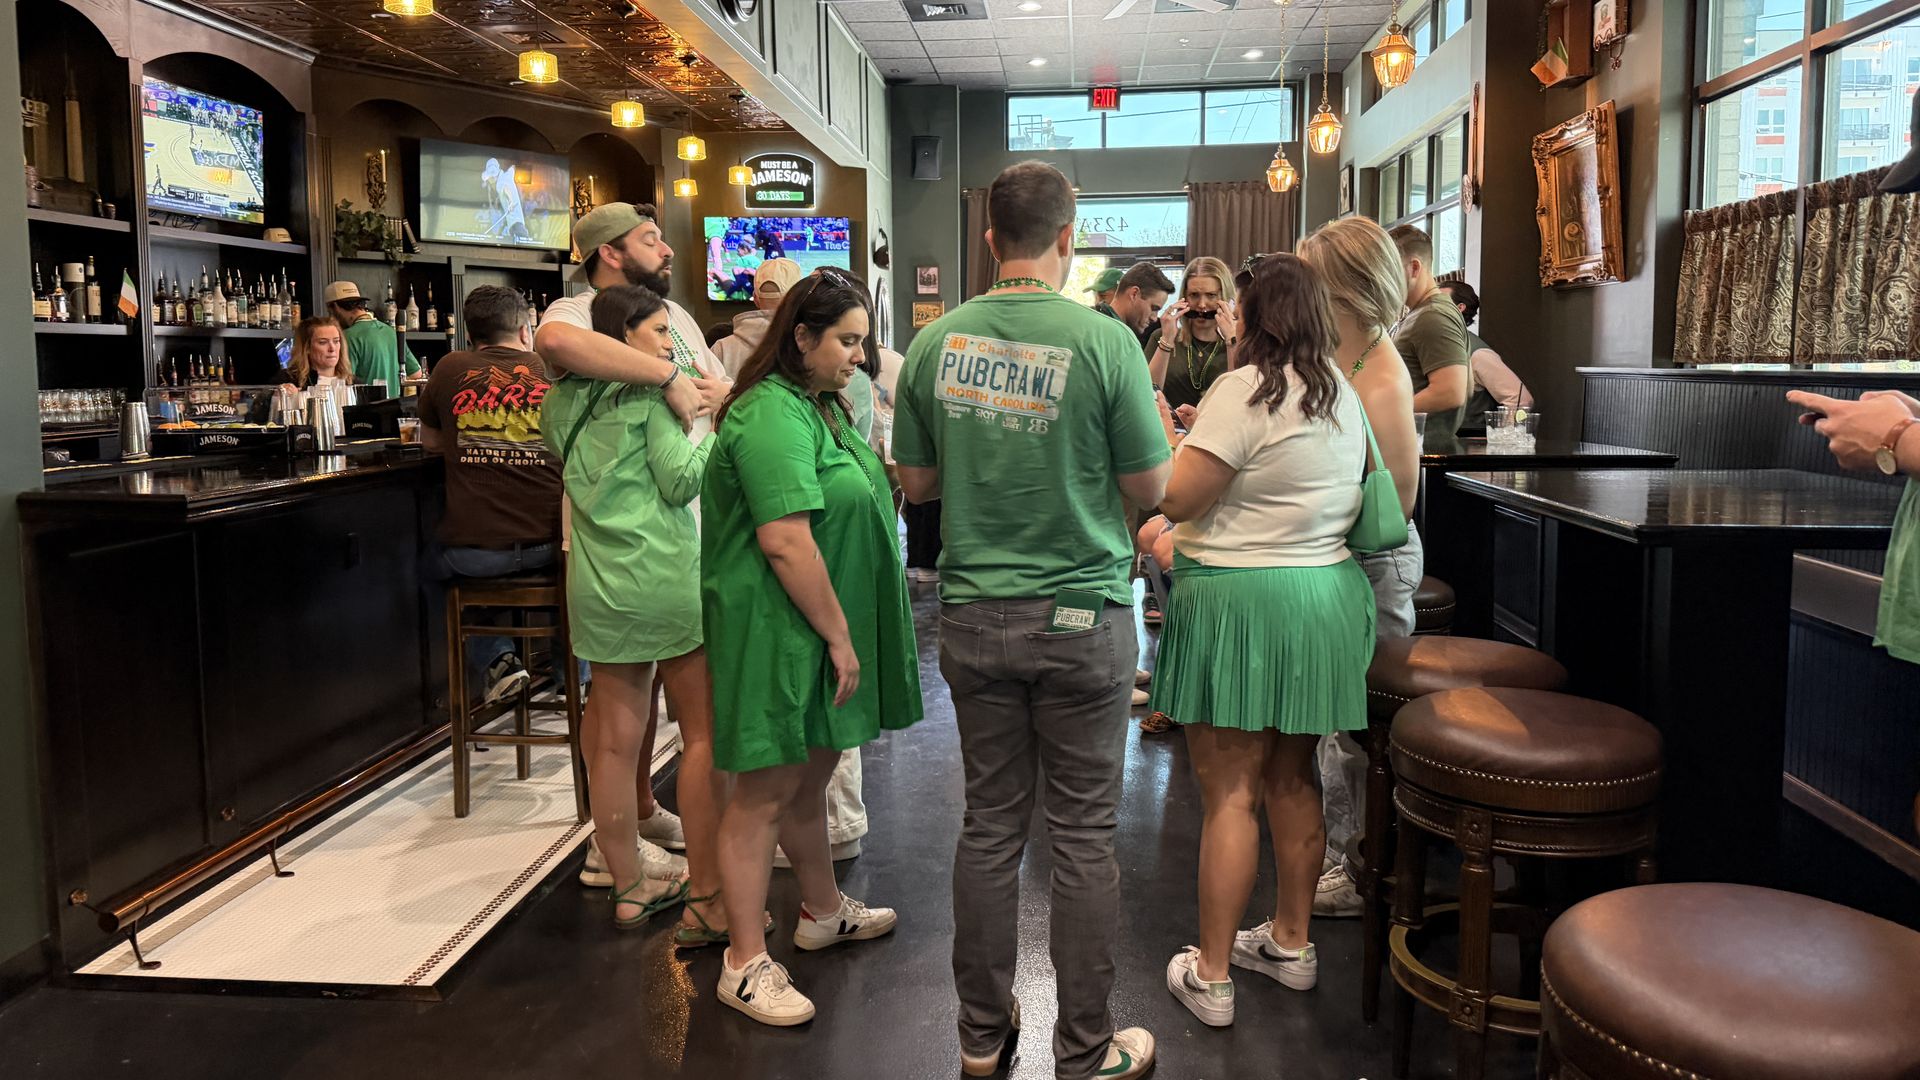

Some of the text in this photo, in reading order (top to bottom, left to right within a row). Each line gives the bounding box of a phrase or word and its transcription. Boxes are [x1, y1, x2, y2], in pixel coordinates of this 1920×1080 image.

[1093, 89, 1117, 108] EXIT
[760, 161, 799, 169] MUST BE A
[750, 170, 808, 187] JAMESON
[769, 190, 791, 200] DAYS
[824, 241, 842, 250] The
[977, 342, 1037, 361] Charlotte
[940, 351, 1058, 401] PUBCRAWL
[946, 386, 1047, 413] NORTH CAROLINA
[195, 404, 236, 415] JAMESON
[199, 434, 240, 446] JAMESON
[466, 448, 539, 459] NATURE IS MY
[460, 456, 488, 464] DRUG
[1215, 987, 1231, 998] NIKE
